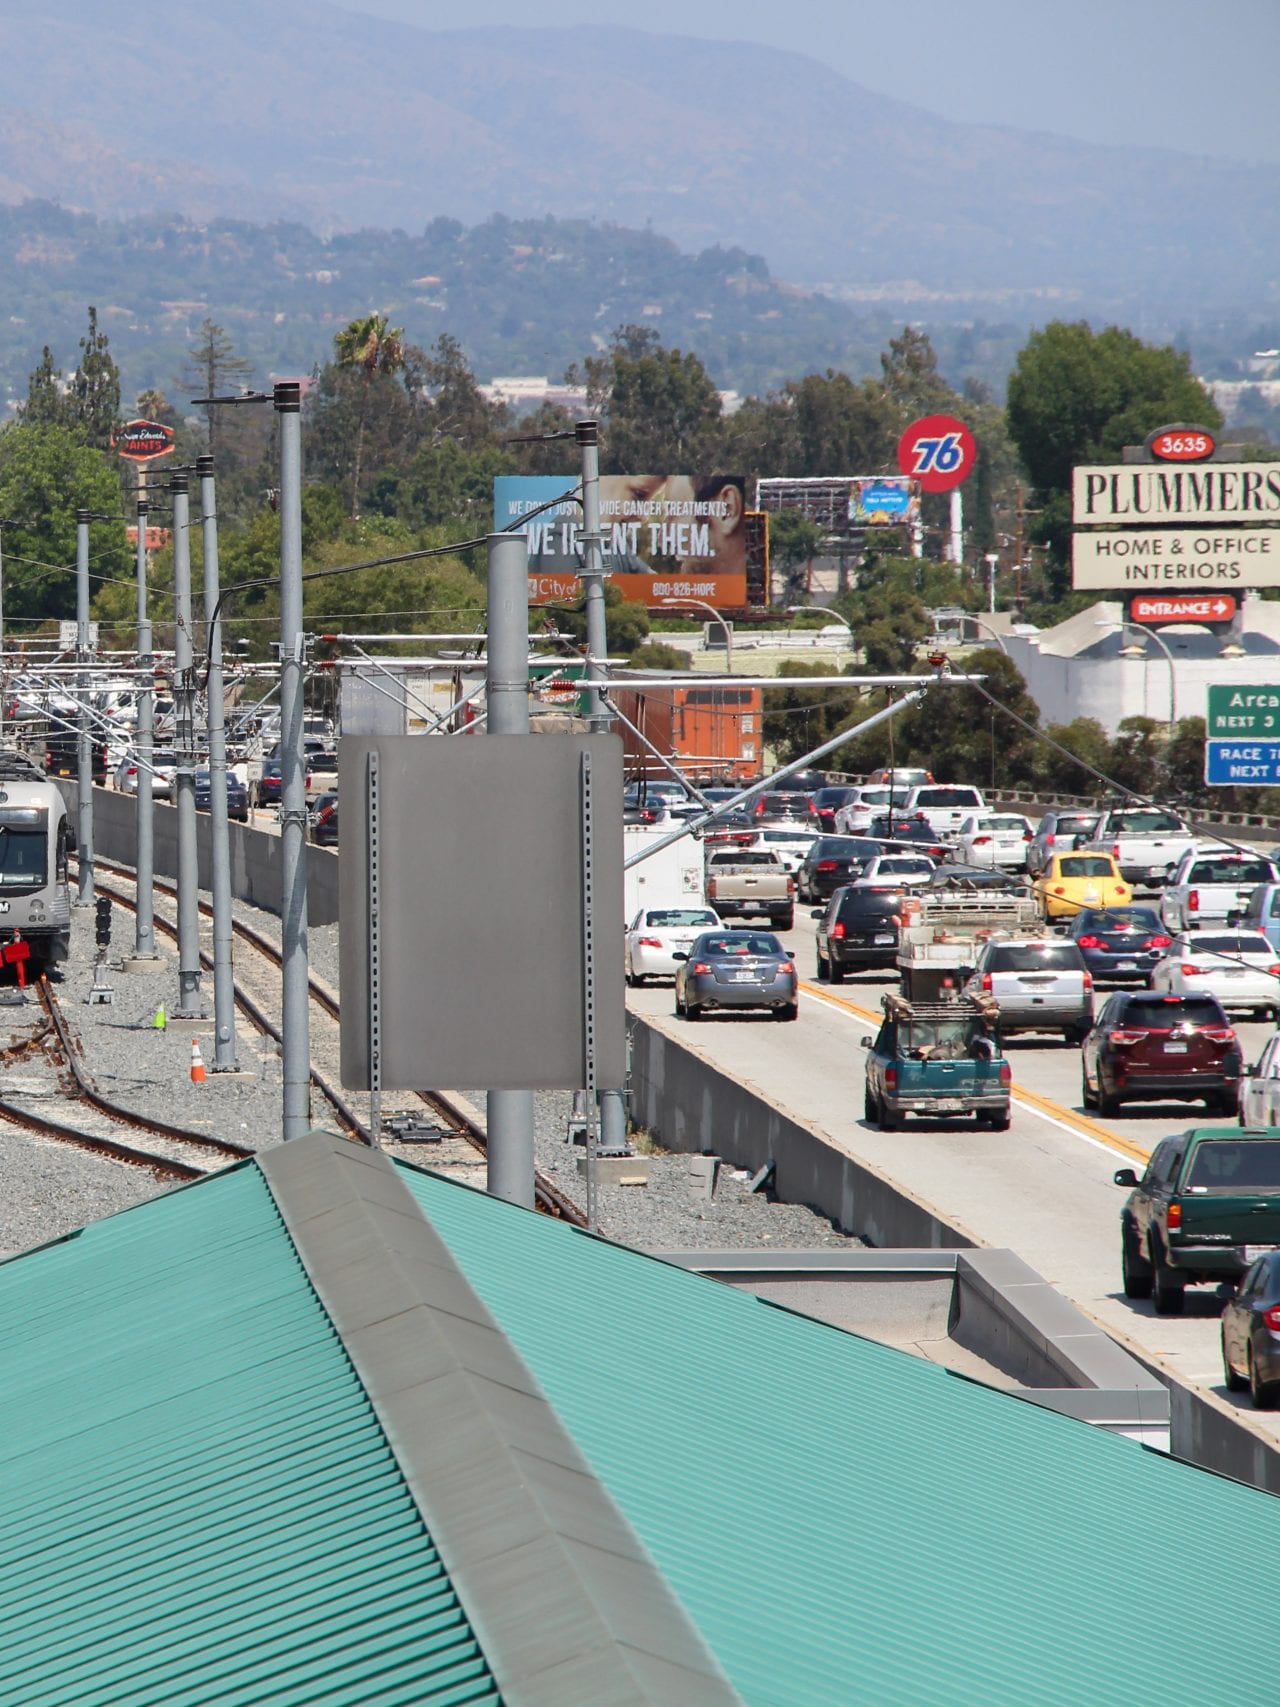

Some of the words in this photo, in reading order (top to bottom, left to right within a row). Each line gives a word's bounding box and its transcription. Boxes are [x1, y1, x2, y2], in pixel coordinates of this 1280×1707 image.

[126, 440, 162, 450] AINTS
[1161, 436, 1207, 453] 3635
[911, 432, 964, 473] 76
[508, 501, 523, 515] WE
[623, 501, 661, 516] CANCER
[665, 501, 730, 516] TREATMENTS.
[648, 523, 716, 557] THEM.
[1096, 539, 1163, 556] HOME
[1170, 538, 1184, 554] &
[1194, 537, 1271, 554] OFFICE
[1126, 562, 1241, 579] INTERIORS
[539, 578, 566, 596] City
[566, 581, 577, 595] of
[652, 582, 716, 597] 800-826-HOPE
[1138, 602, 1210, 615] ENTRANCE
[1215, 715, 1255, 728] NEXT
[1263, 715, 1275, 728] 3
[1220, 748, 1262, 760] RACE
[1230, 765, 1270, 778] NEXT
